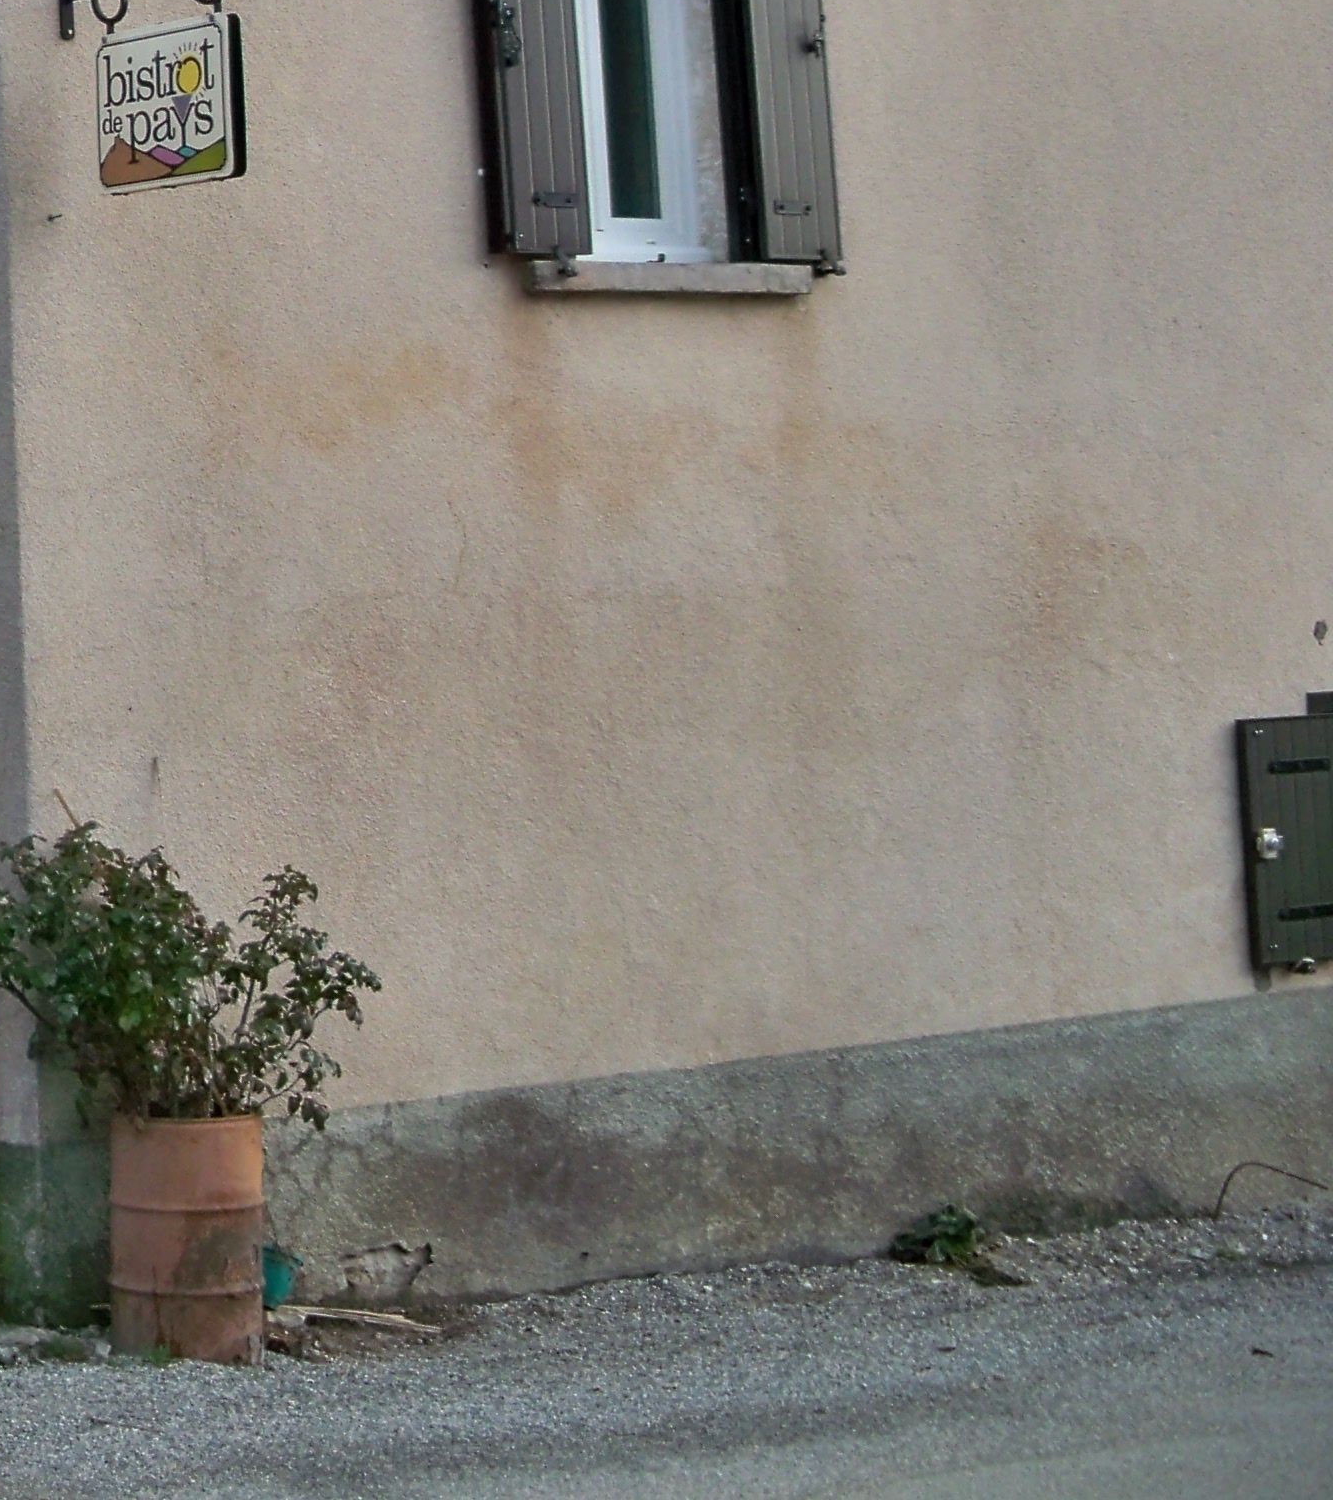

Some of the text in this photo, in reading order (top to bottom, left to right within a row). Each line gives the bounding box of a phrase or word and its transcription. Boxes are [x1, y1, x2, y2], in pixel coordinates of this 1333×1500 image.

[102, 38, 214, 108] bistrot
[102, 99, 213, 164] de pays
